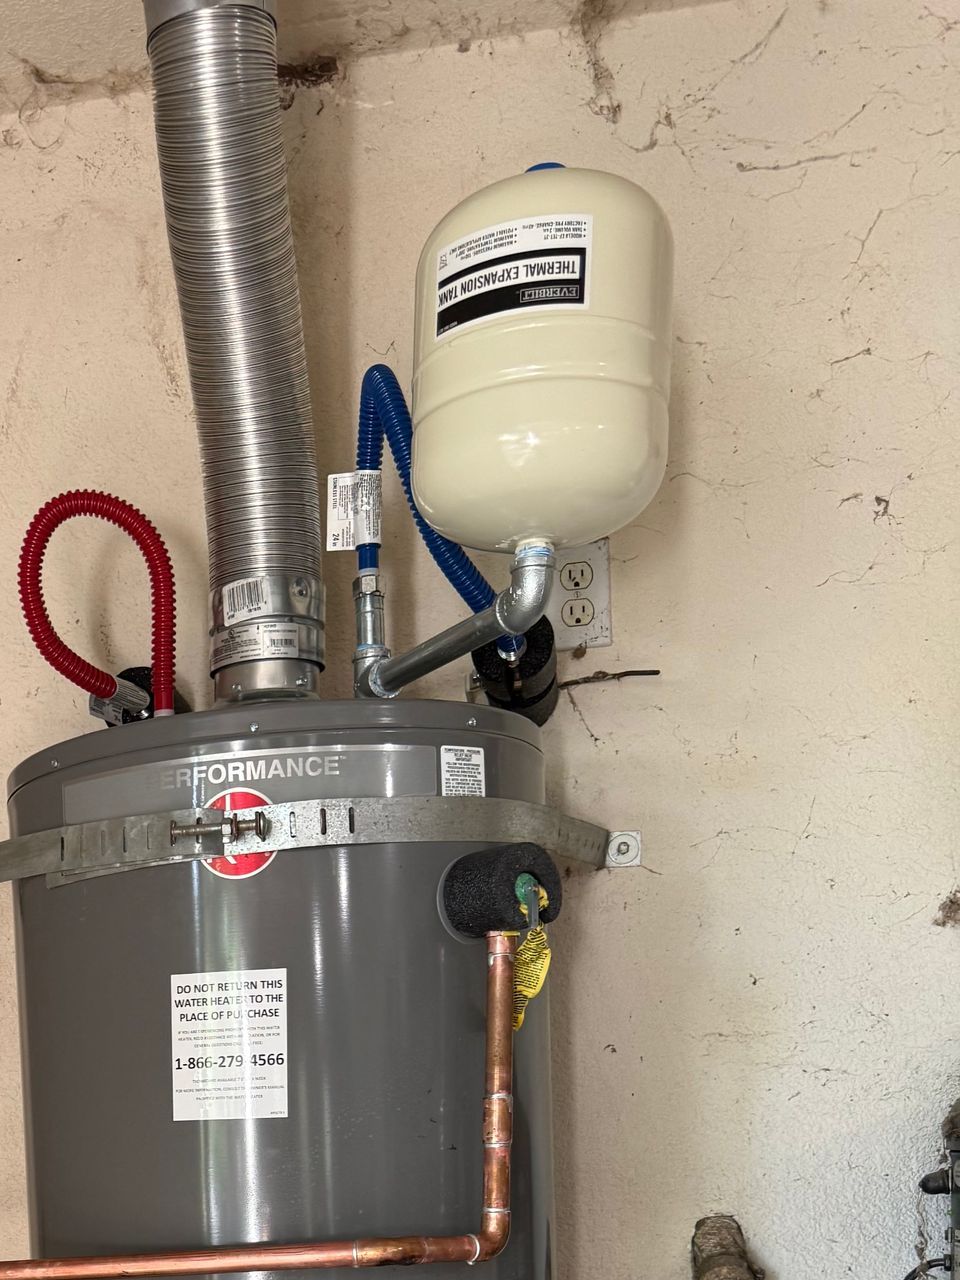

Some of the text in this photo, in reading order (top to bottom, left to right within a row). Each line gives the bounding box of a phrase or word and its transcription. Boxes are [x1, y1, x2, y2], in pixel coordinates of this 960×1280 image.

[439, 261, 577, 307] THERMAL EXPANSION TANK
[522, 288, 576, 300] EVERBILT
[177, 980, 283, 994] DO NOT RETURN THIS
[174, 998, 208, 1008] WATER
[249, 995, 263, 1003] TO
[265, 994, 283, 1003] THE
[180, 1009, 280, 1022] PLACE OF PUCHASE
